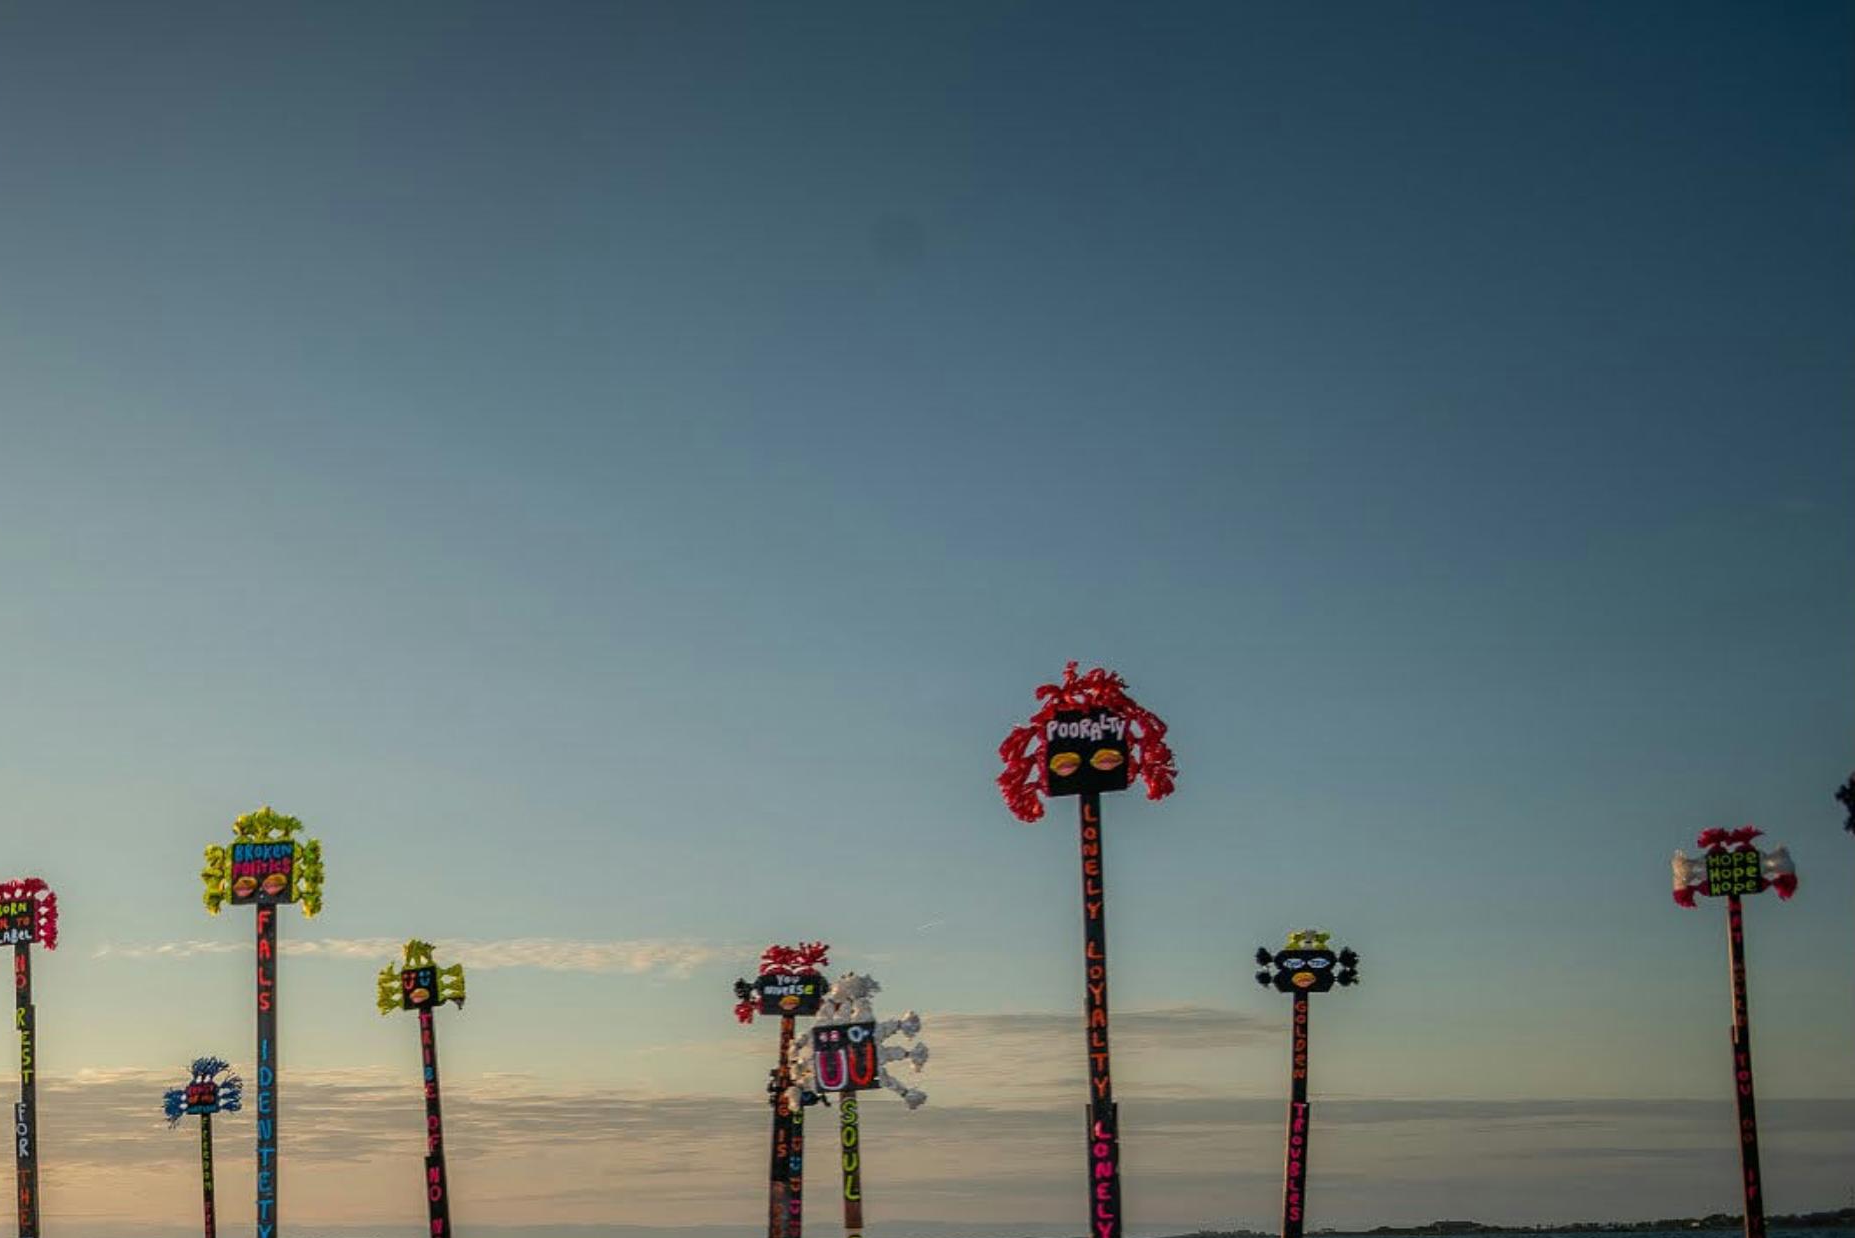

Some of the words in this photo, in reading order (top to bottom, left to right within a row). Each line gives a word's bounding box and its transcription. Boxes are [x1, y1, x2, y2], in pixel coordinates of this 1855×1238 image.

[1047, 714, 1125, 741] POORALTY
[1083, 803, 1102, 919] LONELY
[15, 953, 27, 989] NO
[16, 1007, 33, 1085] REST
[1087, 941, 1109, 1098] LOYALTY
[16, 1103, 29, 1158] FOR
[841, 1098, 860, 1201] SOUL
[17, 1168, 31, 1226] THE
[430, 1166, 443, 1202] NO
